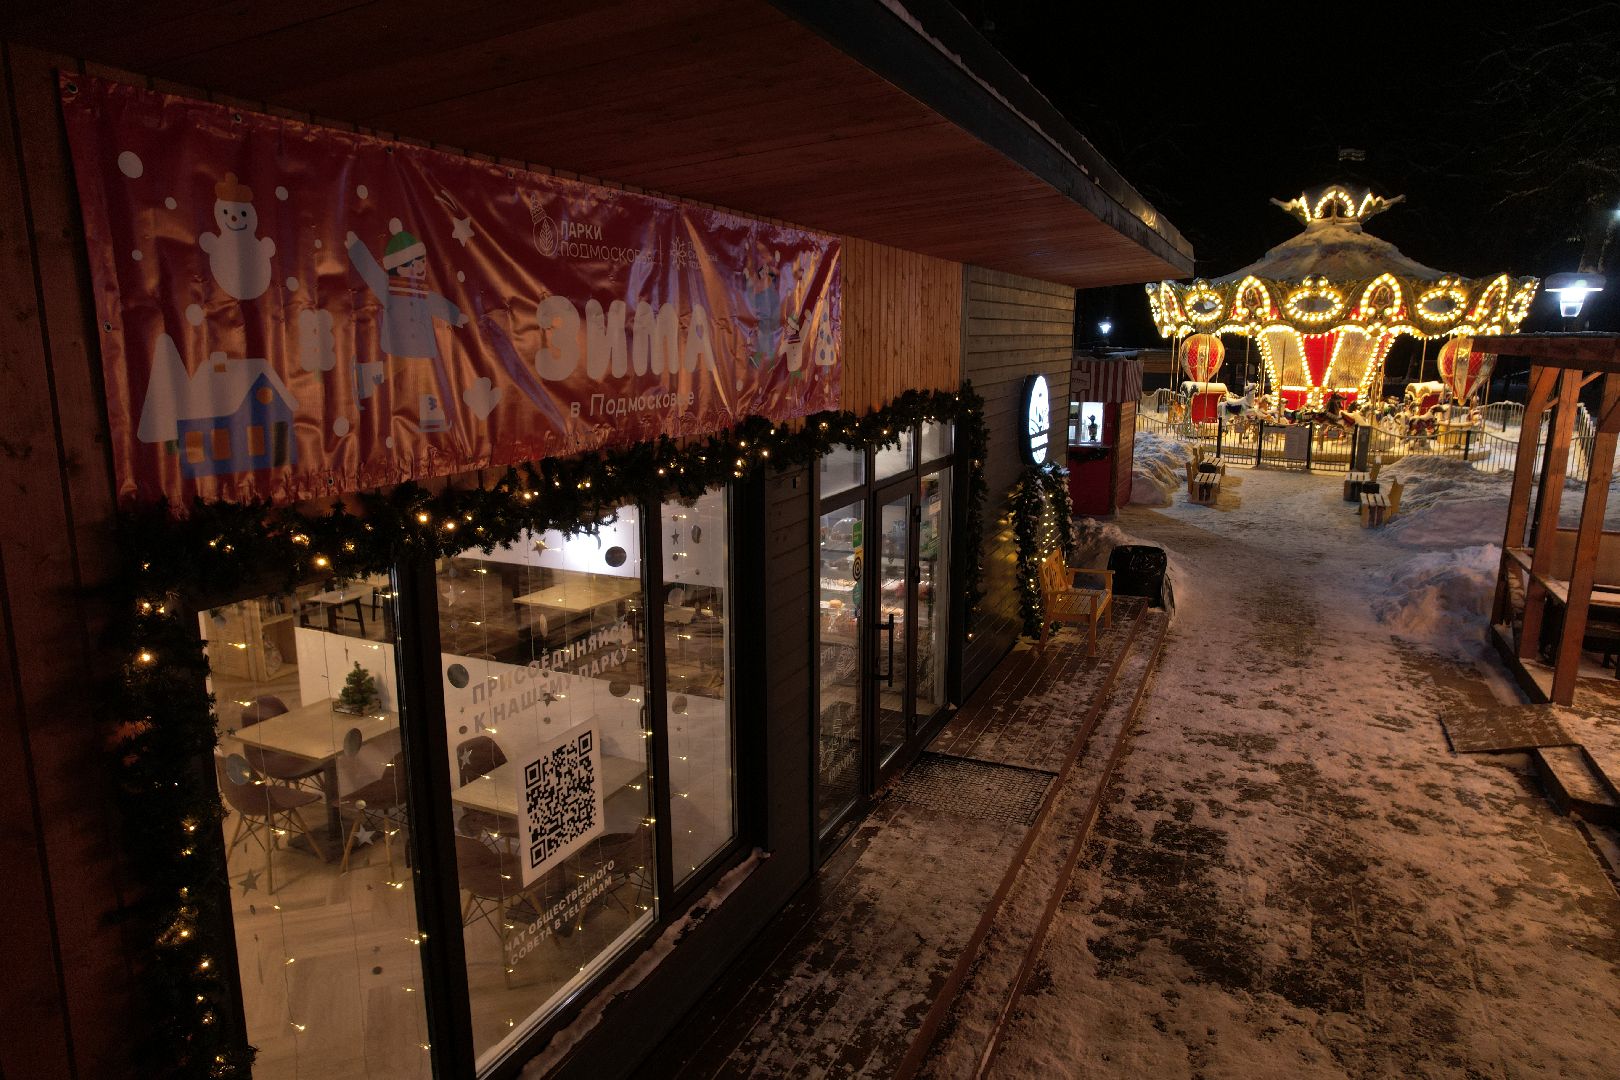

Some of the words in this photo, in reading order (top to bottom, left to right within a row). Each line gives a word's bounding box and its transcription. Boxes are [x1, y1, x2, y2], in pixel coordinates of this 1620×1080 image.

[560, 220, 602, 240] ПАРКИ
[535, 295, 716, 381] ЗИМА
[589, 391, 695, 418] Подмоскове
[473, 712, 487, 733] К
[578, 647, 628, 681] ПАРКУ
[511, 926, 553, 965] СОВЕТА
[554, 918, 561, 930] В
[563, 875, 613, 922] TELEGRAM
[528, 859, 615, 935] ОБЩЕСТВЕННОГО
